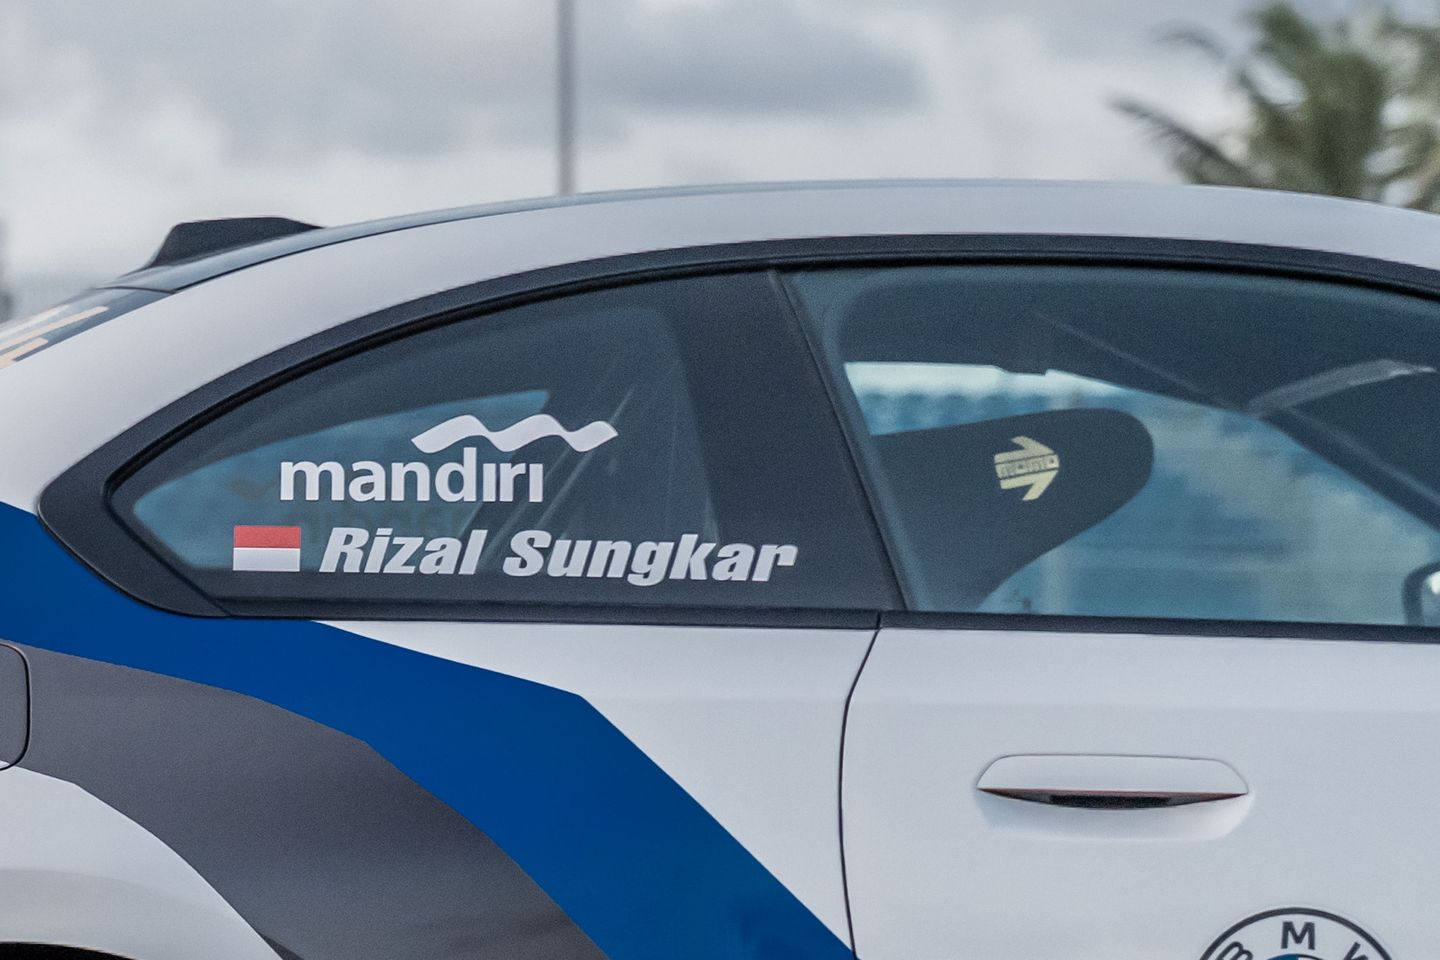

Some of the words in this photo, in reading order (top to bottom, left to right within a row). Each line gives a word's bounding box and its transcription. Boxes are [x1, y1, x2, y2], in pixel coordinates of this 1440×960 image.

[280, 446, 544, 502] mandiri
[318, 526, 488, 576] Rizal
[502, 529, 798, 587] Sungkar
